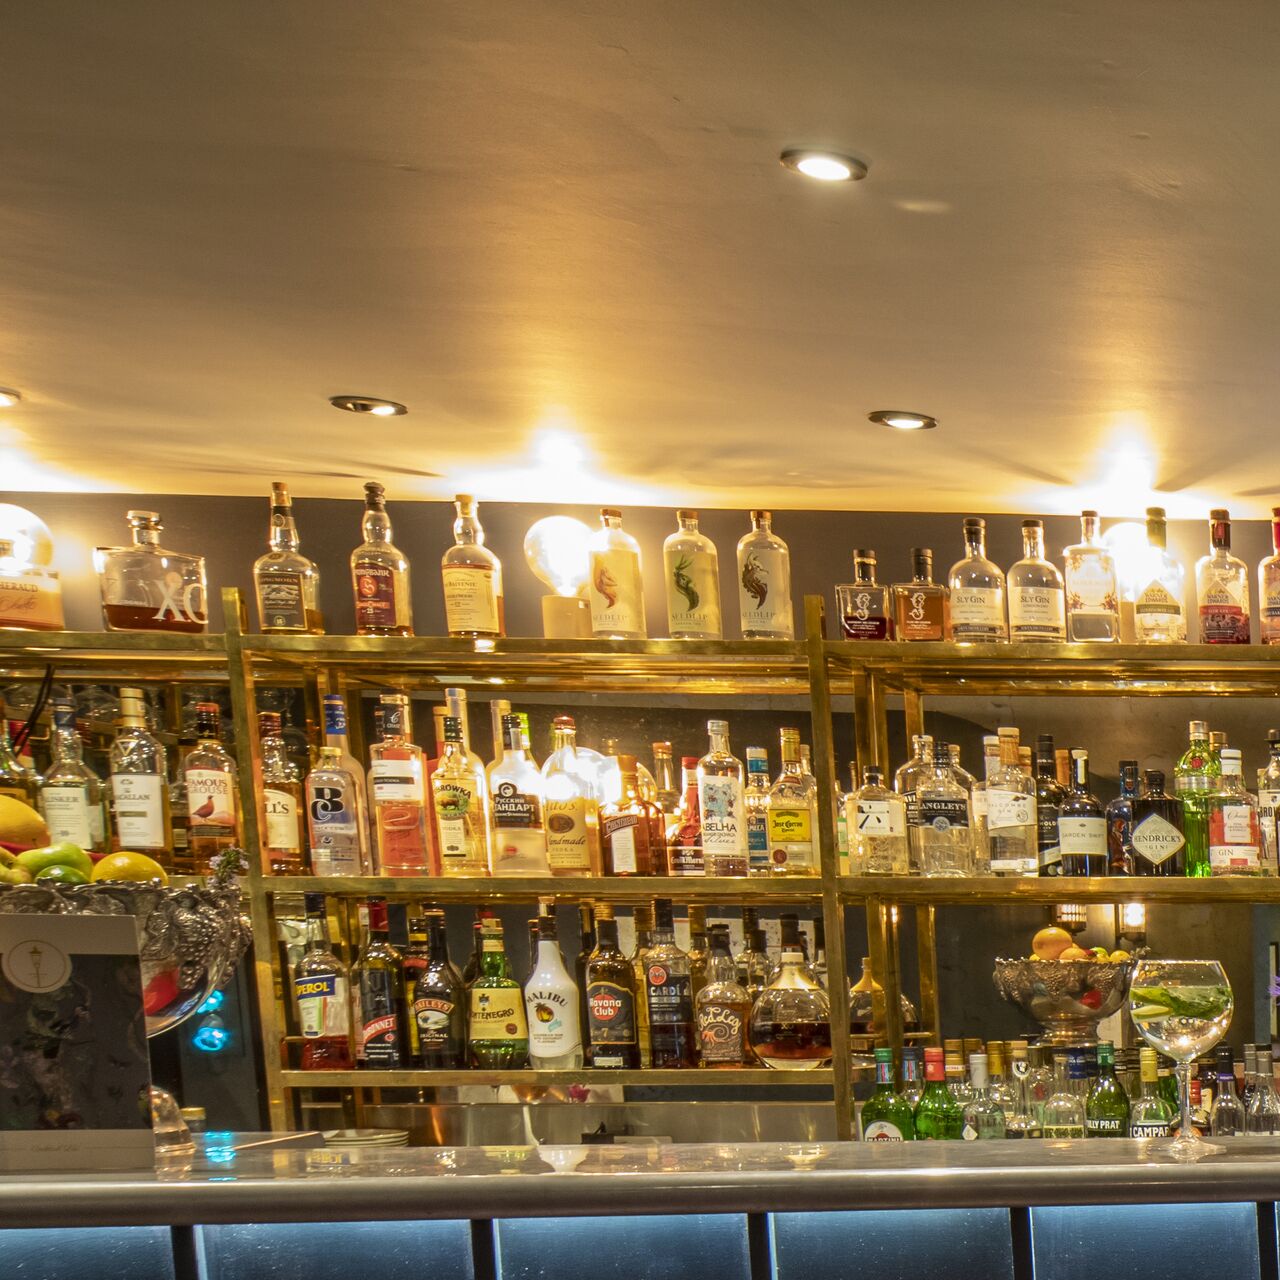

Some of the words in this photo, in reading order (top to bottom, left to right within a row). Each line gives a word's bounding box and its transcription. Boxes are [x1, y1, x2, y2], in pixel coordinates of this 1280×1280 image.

[0, 582, 39, 592] HERAUD
[956, 595, 969, 604] SLY
[970, 595, 985, 604] GIN
[1020, 595, 1034, 604] SLY
[1034, 595, 1050, 604] GIN
[264, 801, 289, 814] LL'S
[1218, 848, 1234, 857] GIN
[650, 984, 680, 996] CARDÍ
[527, 991, 568, 1007] MALIBU
[594, 1007, 615, 1016] Club
[601, 1027, 609, 1038] 7
[1100, 1120, 1120, 1129] PRAT
[1132, 1126, 1168, 1138] CAMPA
